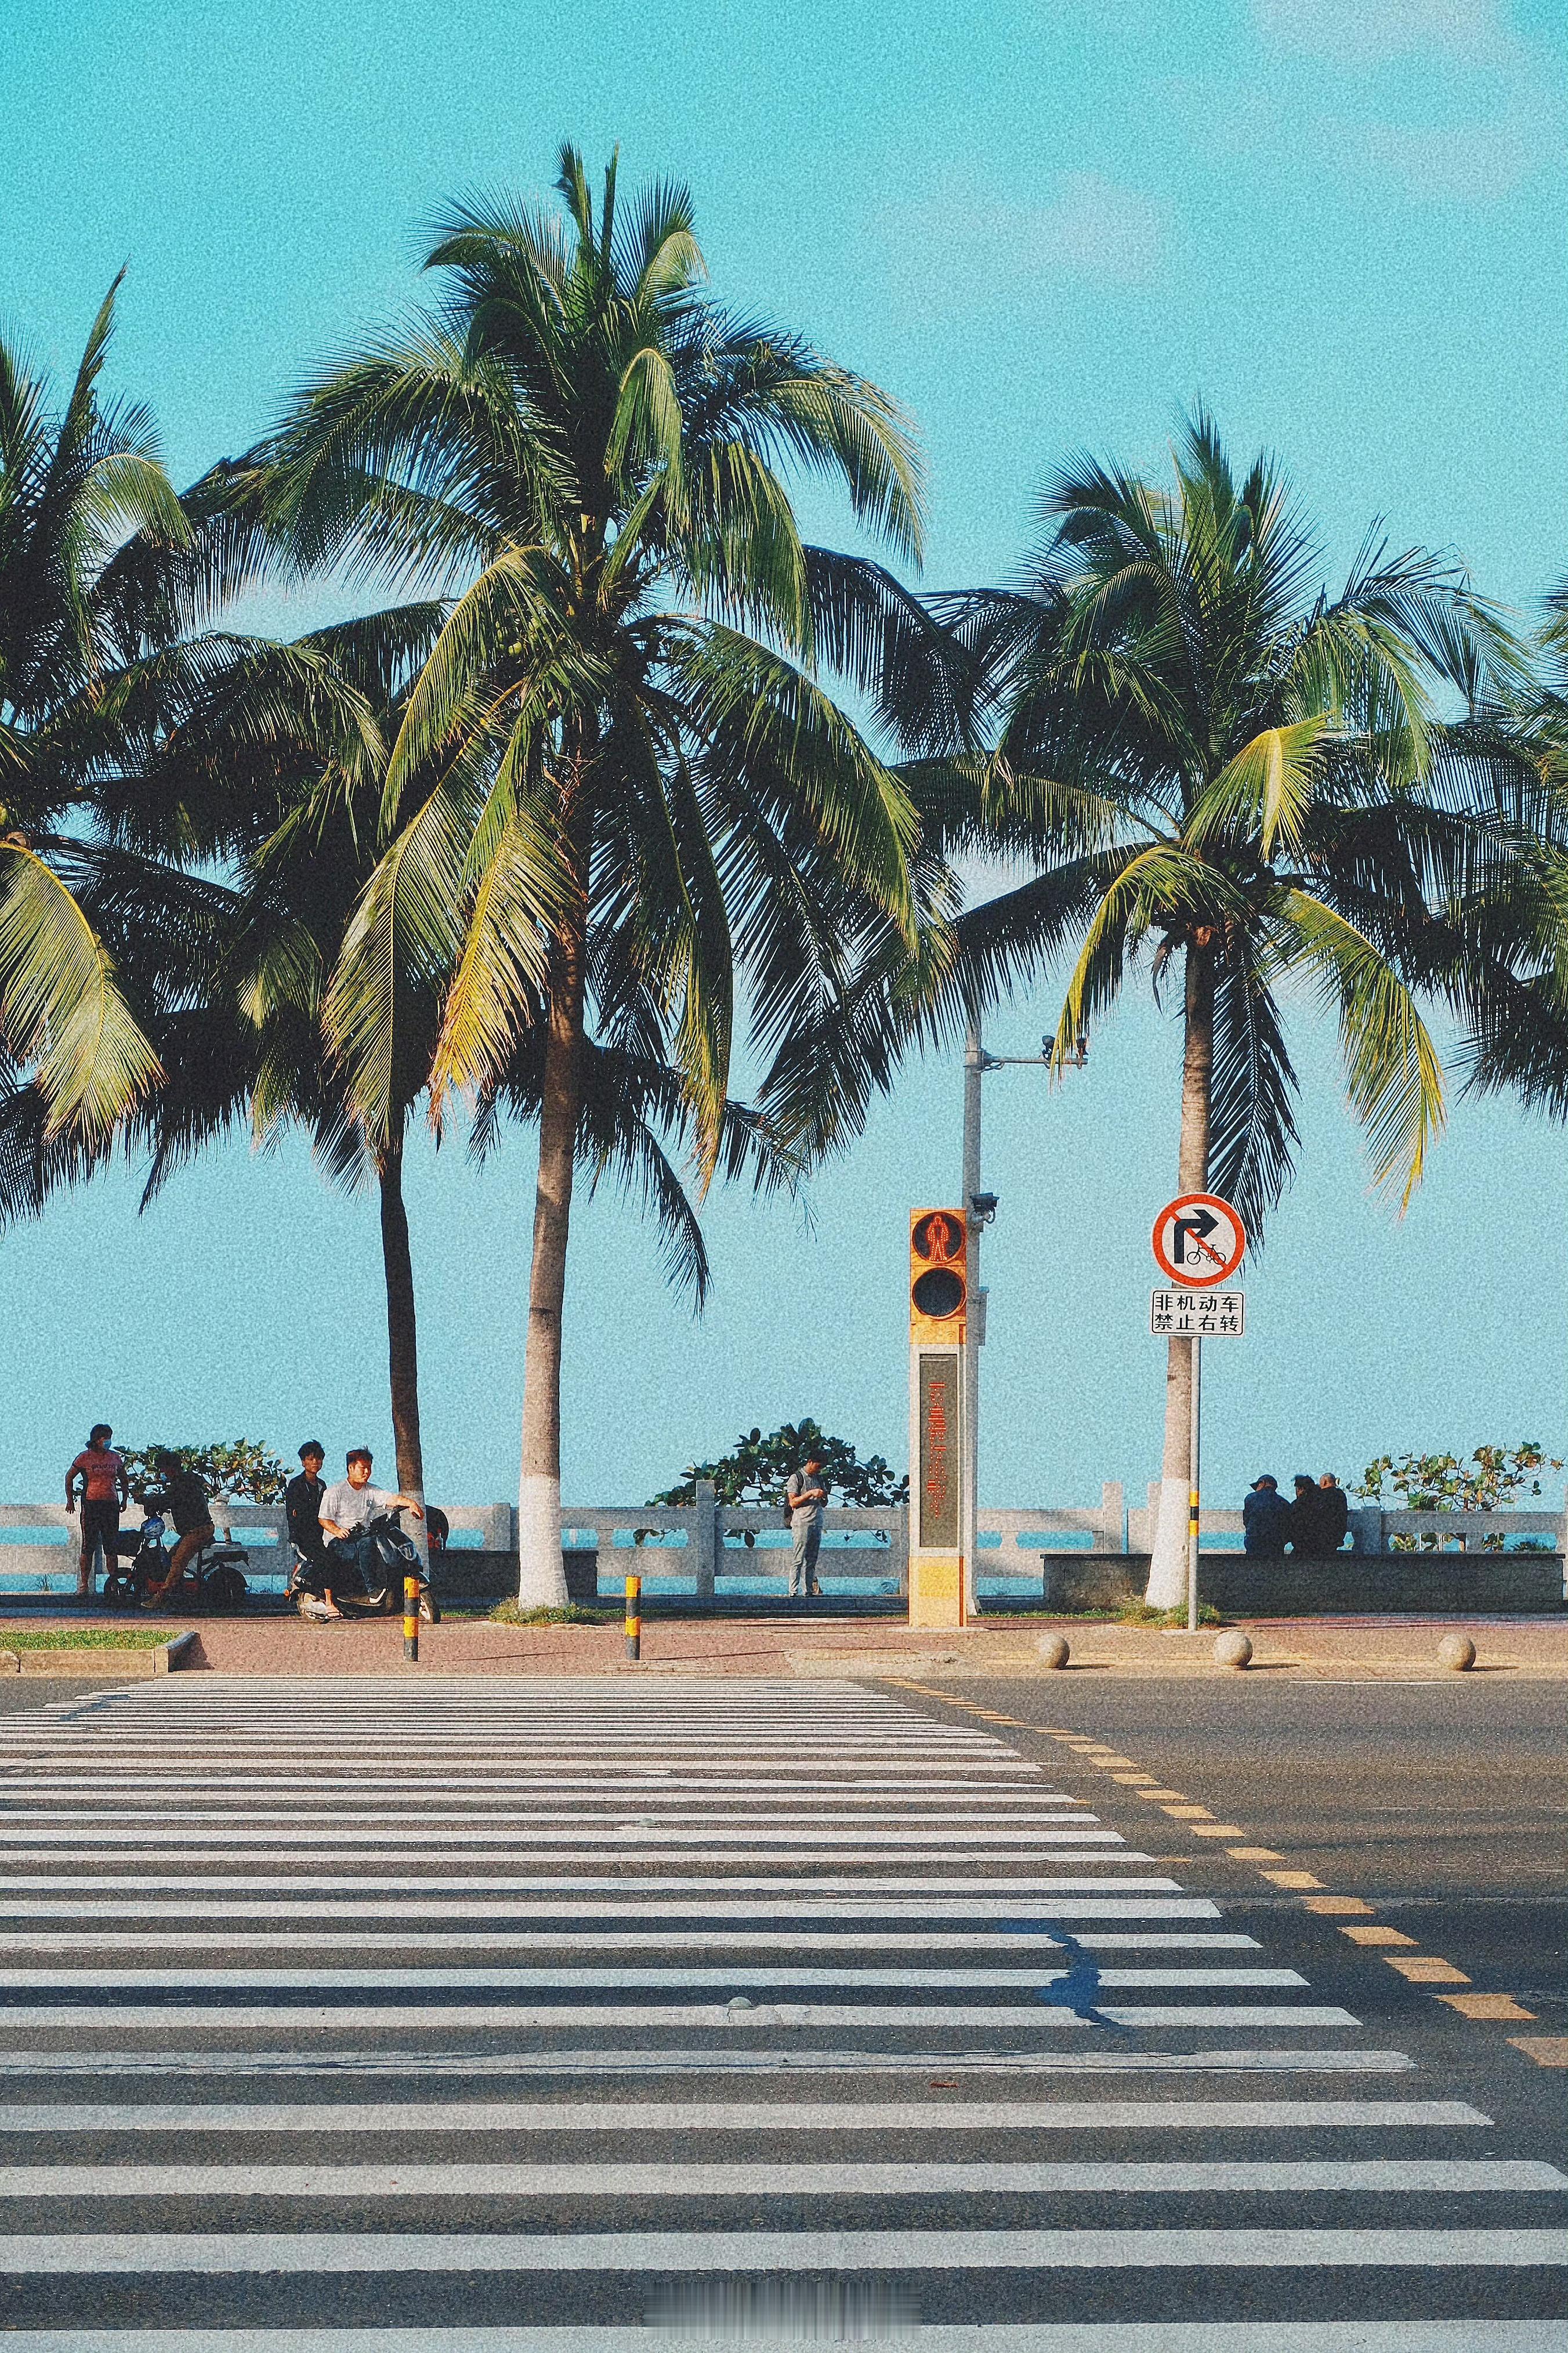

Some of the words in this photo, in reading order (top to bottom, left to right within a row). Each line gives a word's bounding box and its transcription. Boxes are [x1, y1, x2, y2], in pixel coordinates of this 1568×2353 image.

[1155, 1294, 1239, 1313] 非机动车
[1155, 1313, 1239, 1332] 禁止右转
